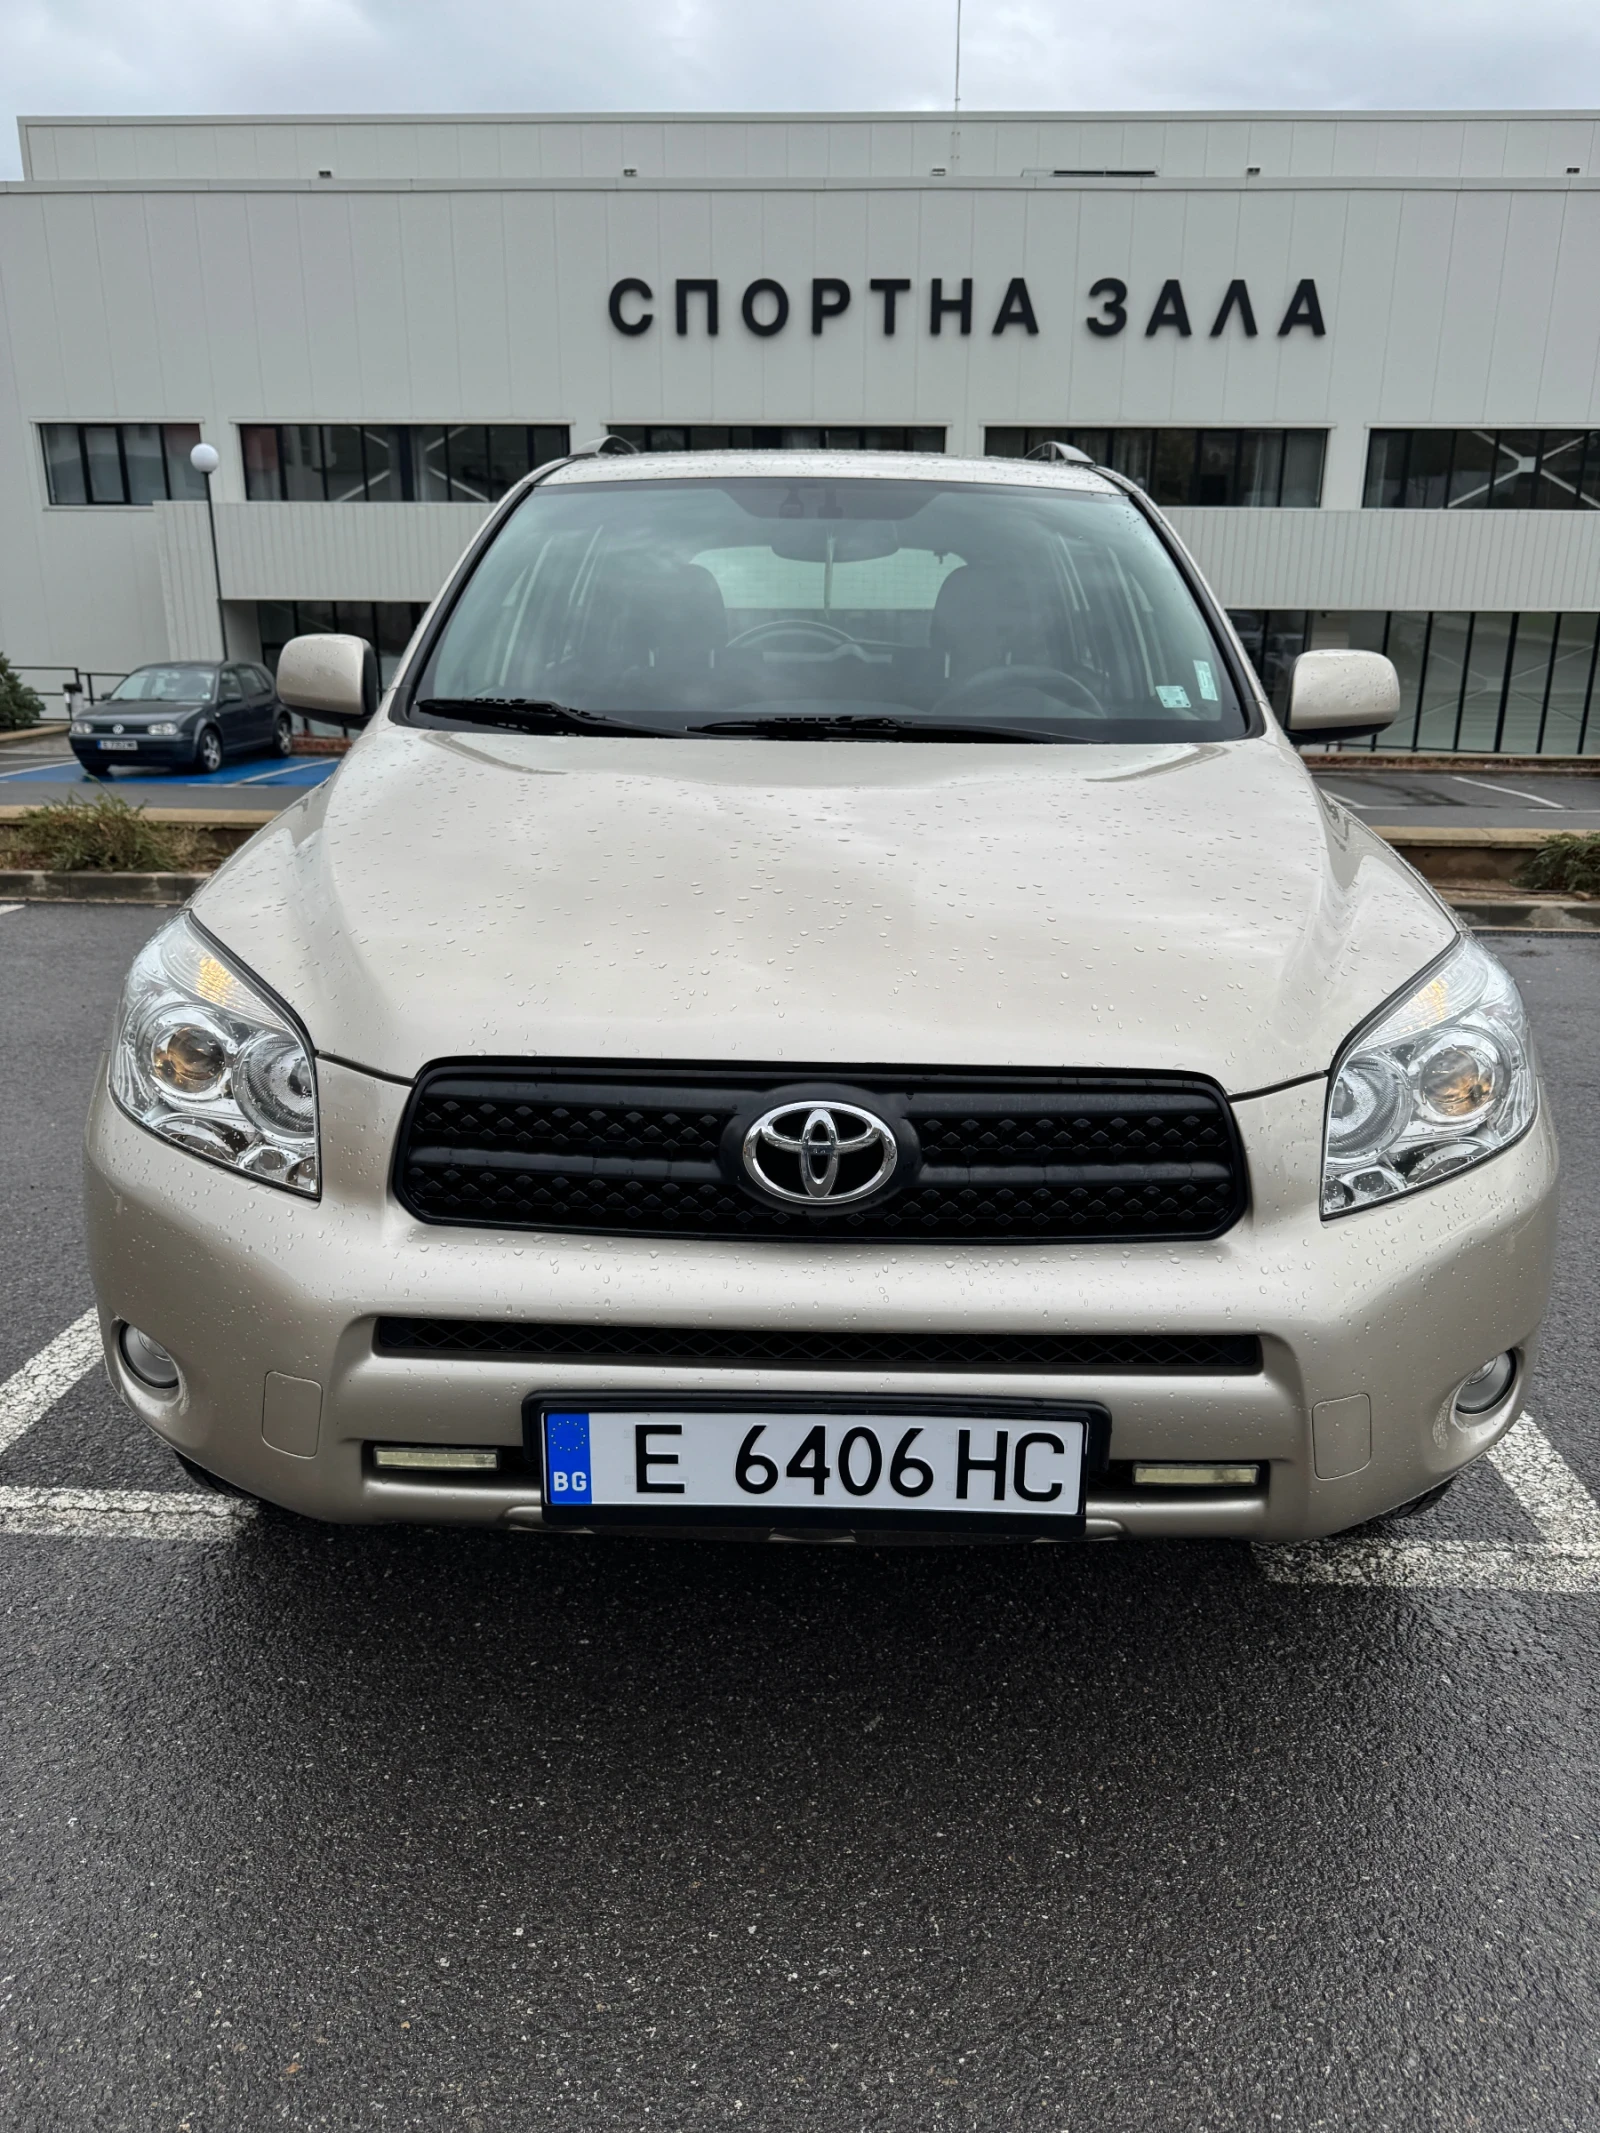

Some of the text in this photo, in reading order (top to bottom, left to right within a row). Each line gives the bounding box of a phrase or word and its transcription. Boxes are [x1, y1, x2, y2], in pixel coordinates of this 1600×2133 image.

[609, 278, 1326, 338] СПОРТНА ЗАЛА
[553, 1471, 587, 1491] BG
[635, 1424, 1065, 1503] E 6406 HC
